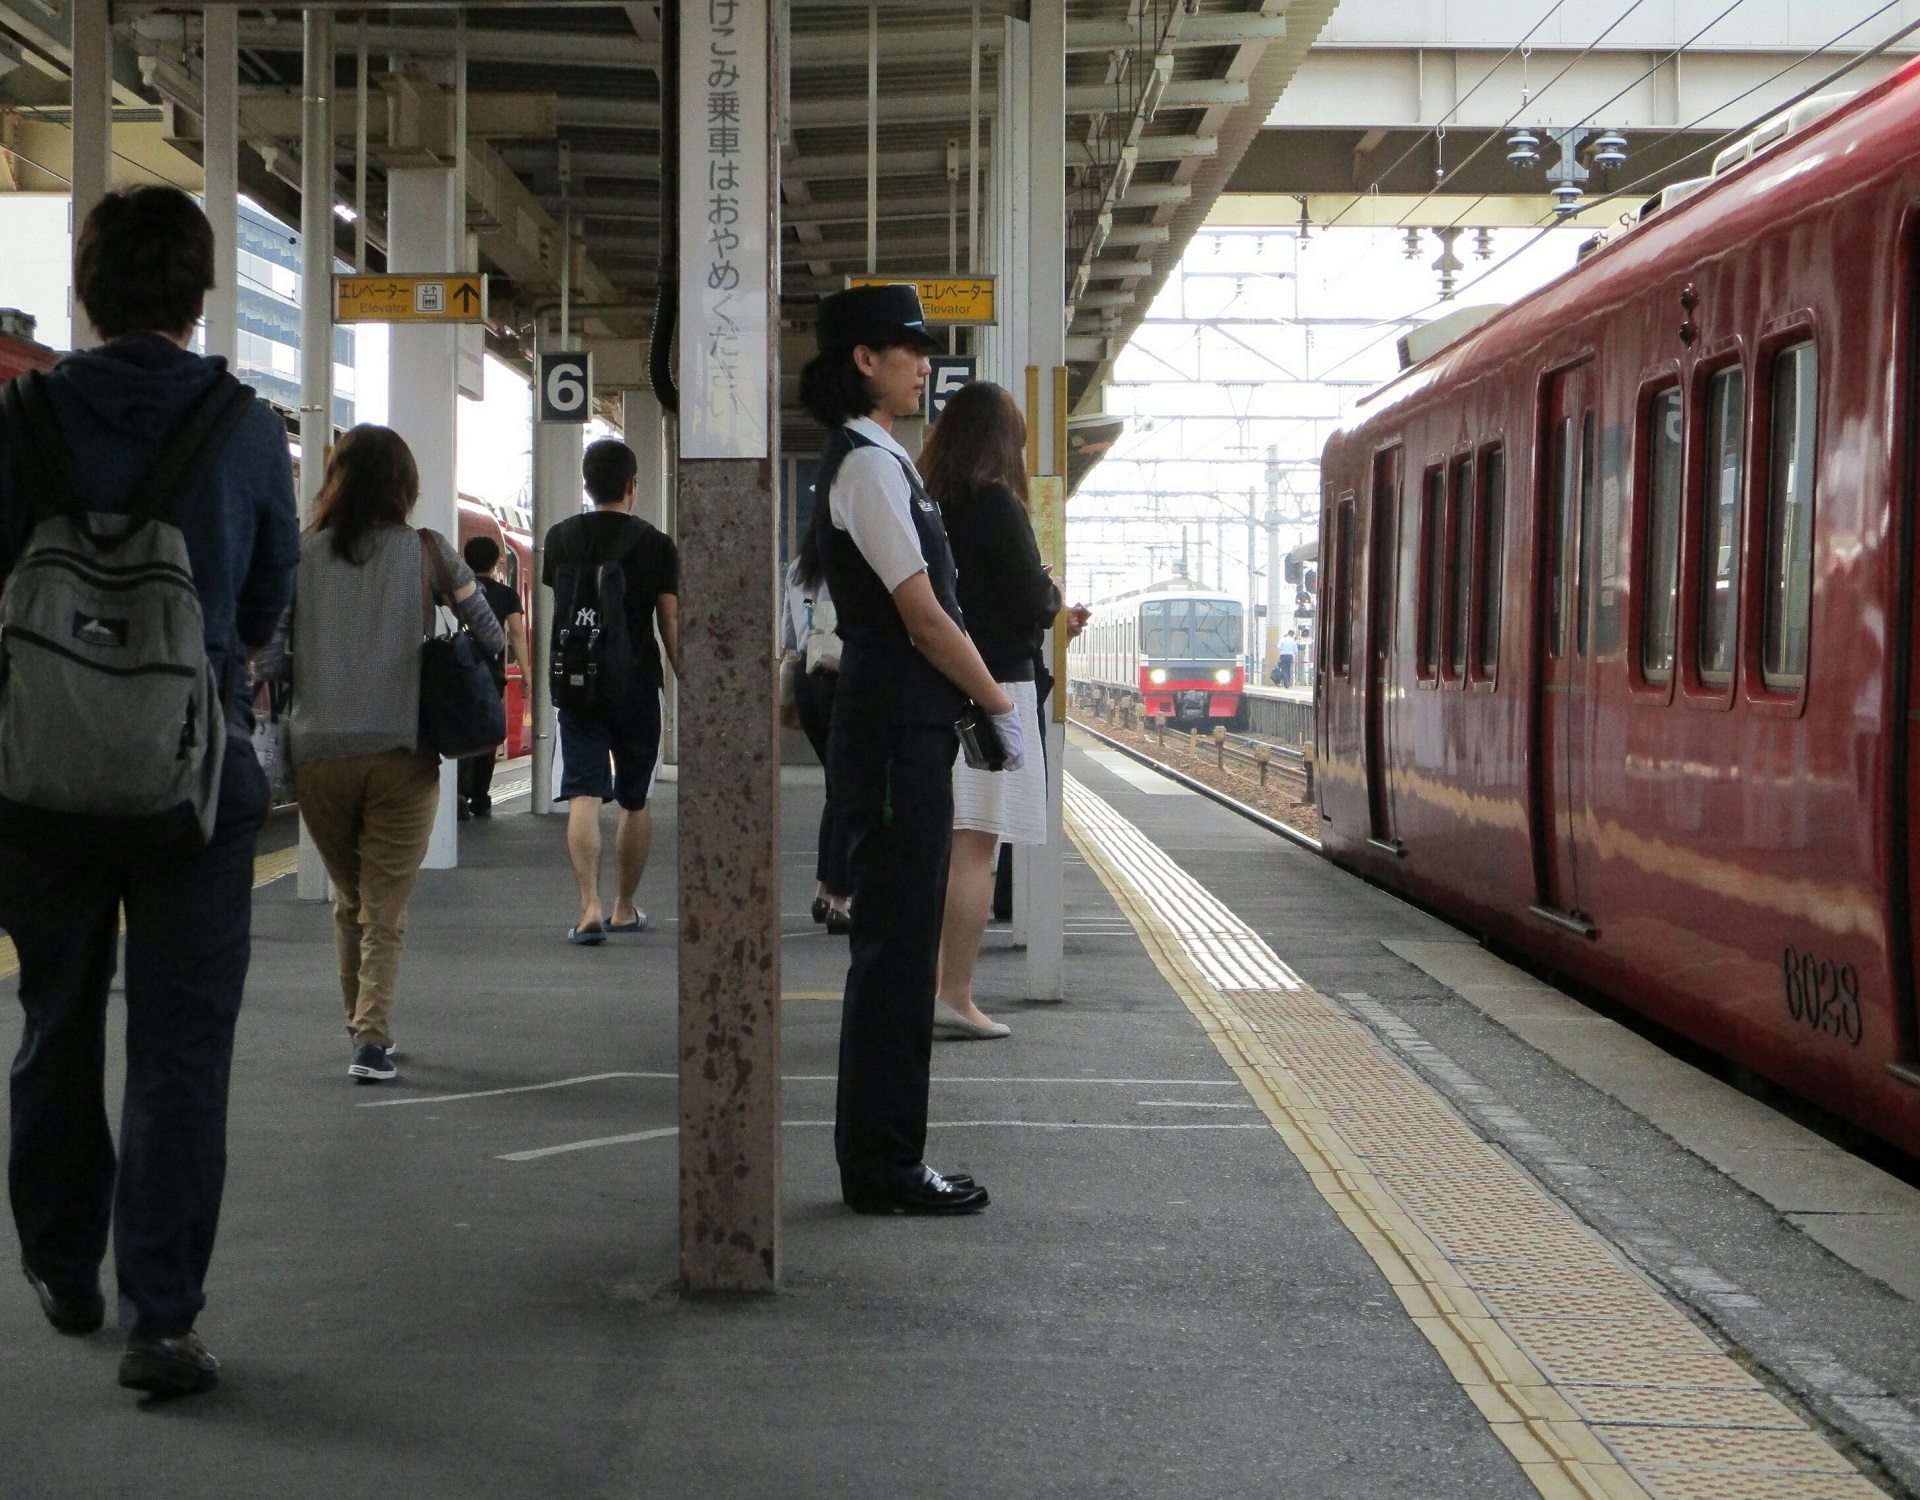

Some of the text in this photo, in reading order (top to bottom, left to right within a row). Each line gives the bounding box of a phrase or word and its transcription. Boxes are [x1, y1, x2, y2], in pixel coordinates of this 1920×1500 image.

[340, 283, 410, 299] エレベーター
[922, 283, 993, 300] エレベーター
[359, 302, 409, 314] Elevator
[922, 303, 971, 314] Elevator
[547, 363, 585, 412] 6
[933, 366, 970, 412] 5
